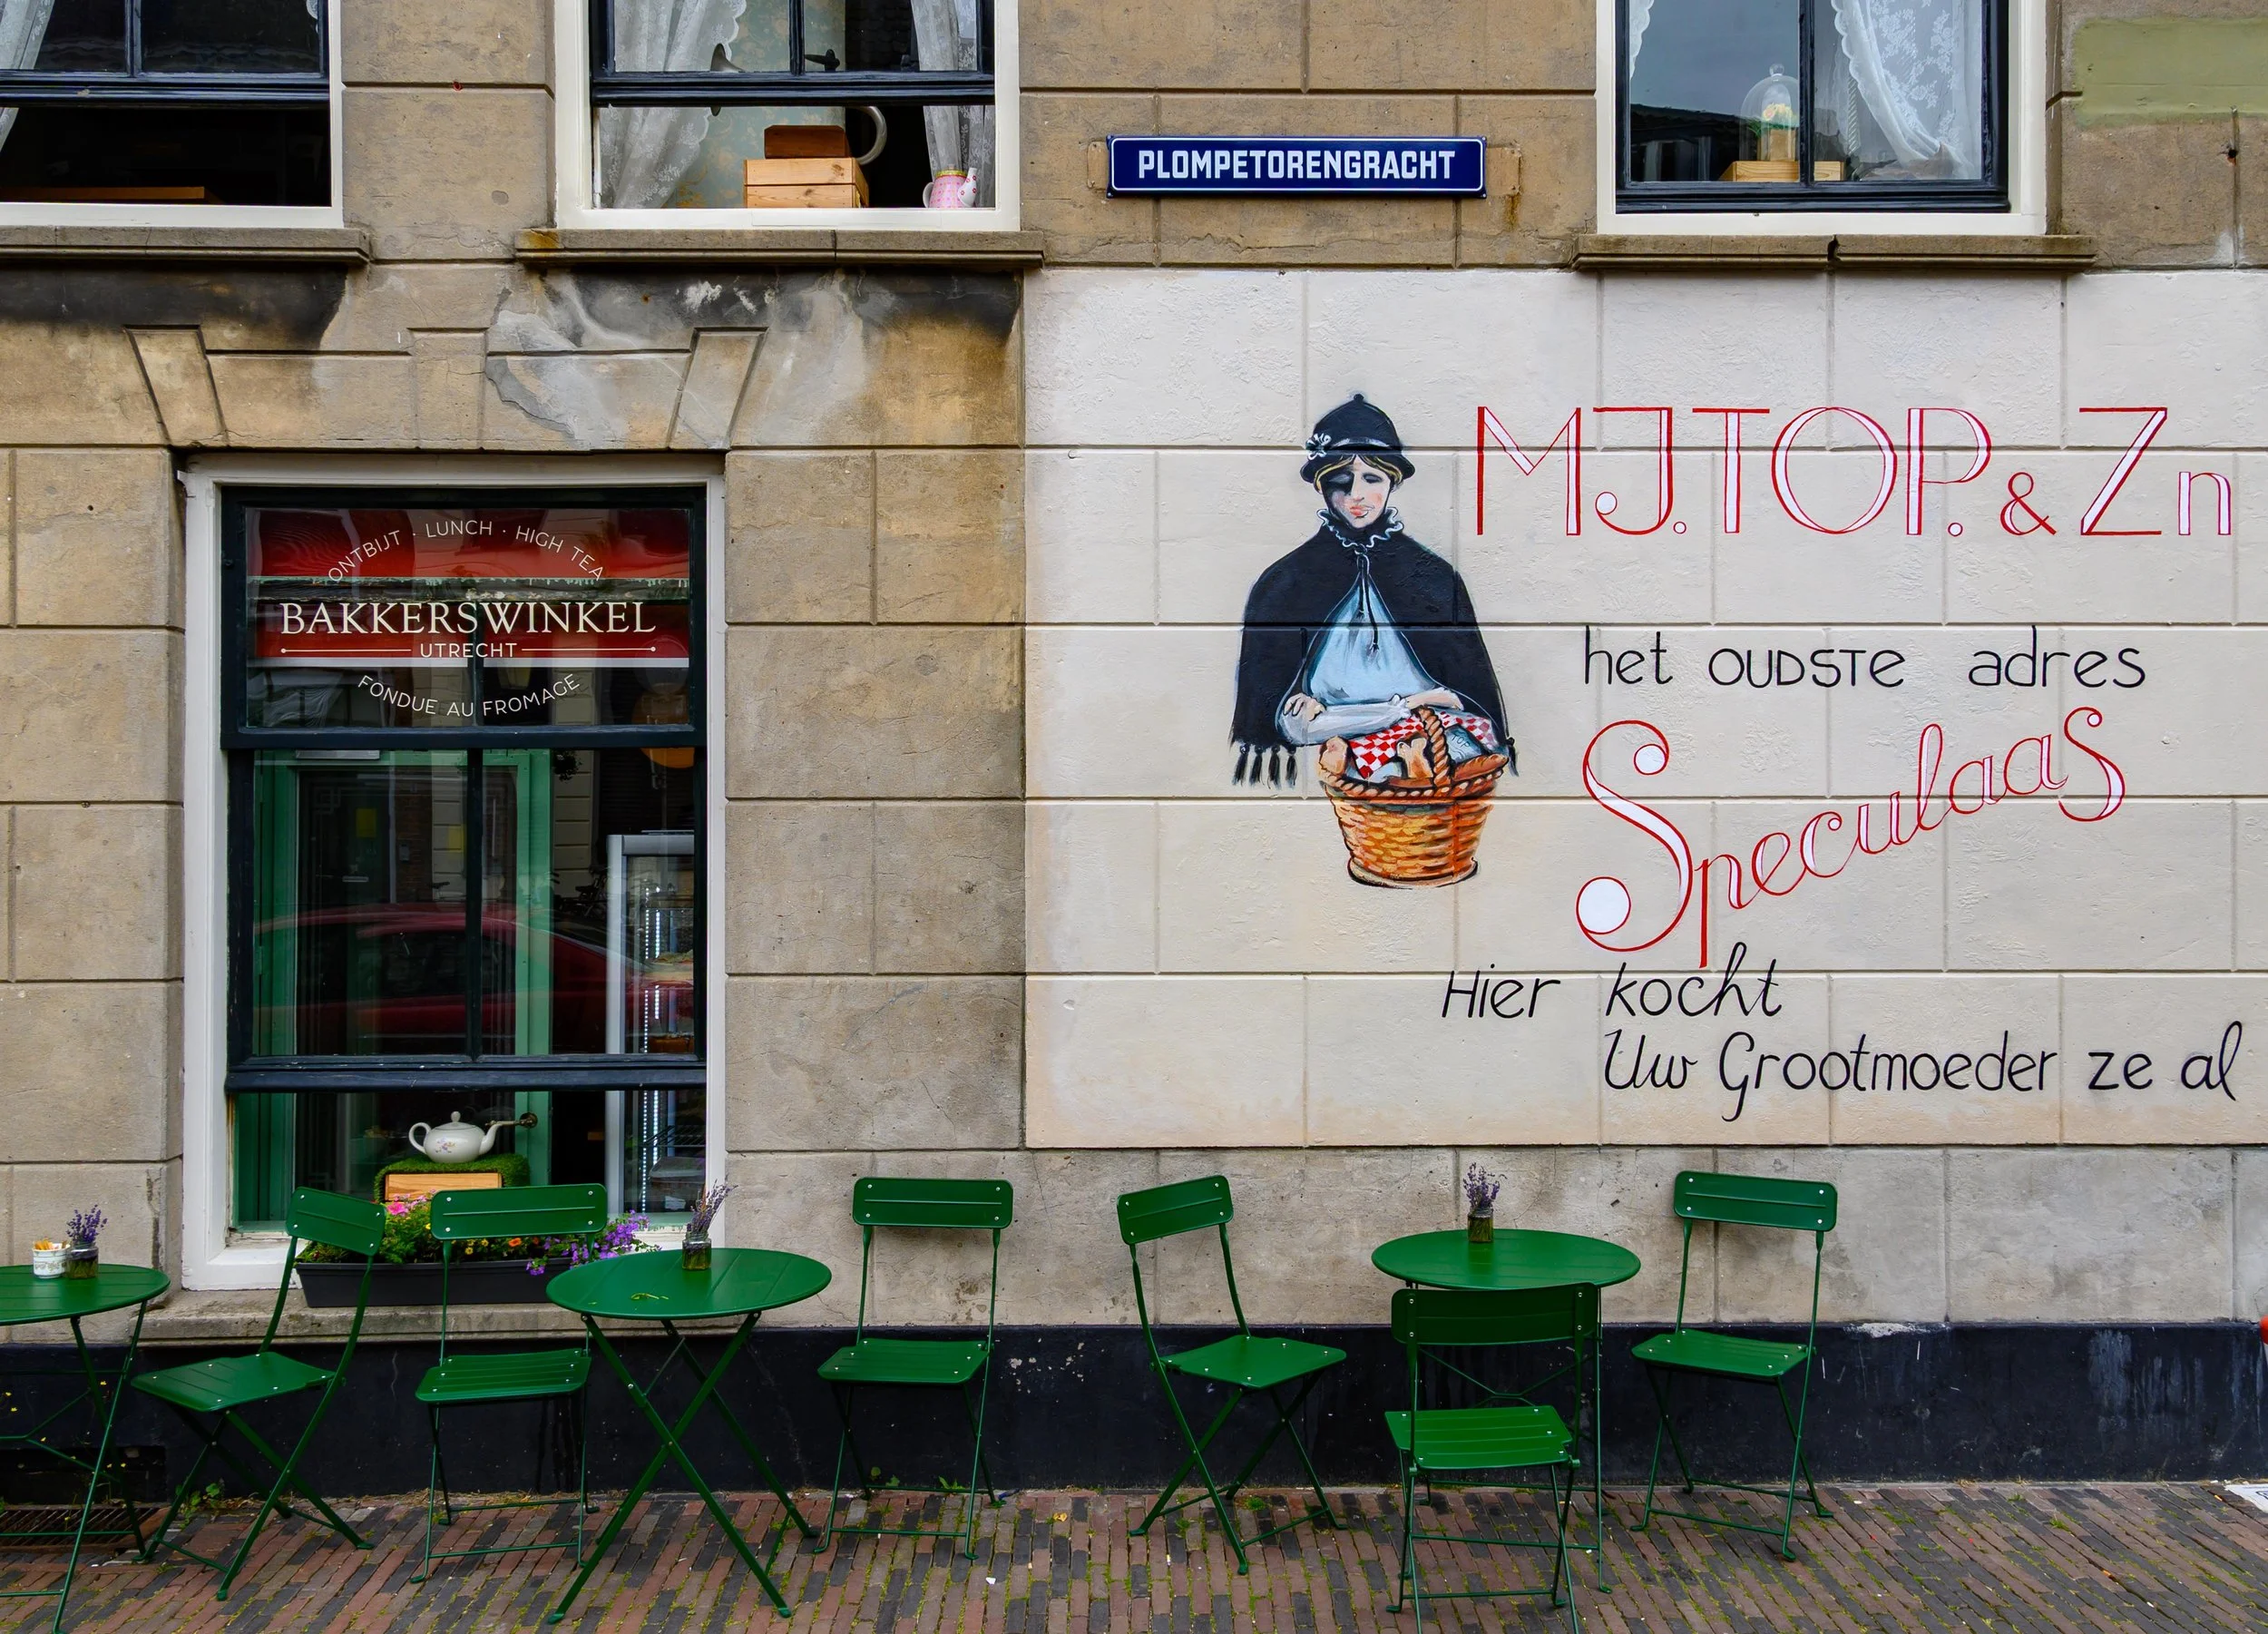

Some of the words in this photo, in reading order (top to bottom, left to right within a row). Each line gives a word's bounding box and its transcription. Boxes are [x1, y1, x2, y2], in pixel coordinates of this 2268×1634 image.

[1139, 150, 1456, 179] PLOMPETORENGRACHT
[2000, 472, 2057, 536] &
[2078, 406, 2232, 536] Zn
[327, 530, 401, 582] ONTBIJT
[425, 520, 493, 538] LUNCH
[515, 525, 564, 553] HIGH
[570, 546, 604, 582] TEA
[279, 601, 657, 636] BAKKERSWINKEL
[420, 643, 518, 659] UTRECHT
[1578, 623, 1674, 685] het
[1968, 623, 2146, 688] adres
[357, 674, 439, 715] FONDUE
[446, 701, 474, 717] AU
[483, 673, 581, 716] FROMAGE
[1452, 734, 1470, 748] TOP
[1442, 964, 1561, 1018] Hier
[1605, 941, 1783, 1017] kocht
[1604, 1029, 1698, 1090] Uw
[1719, 1031, 2058, 1122] Grootmoeder
[2087, 1052, 2154, 1091] ze
[2180, 1021, 2243, 1101] al
